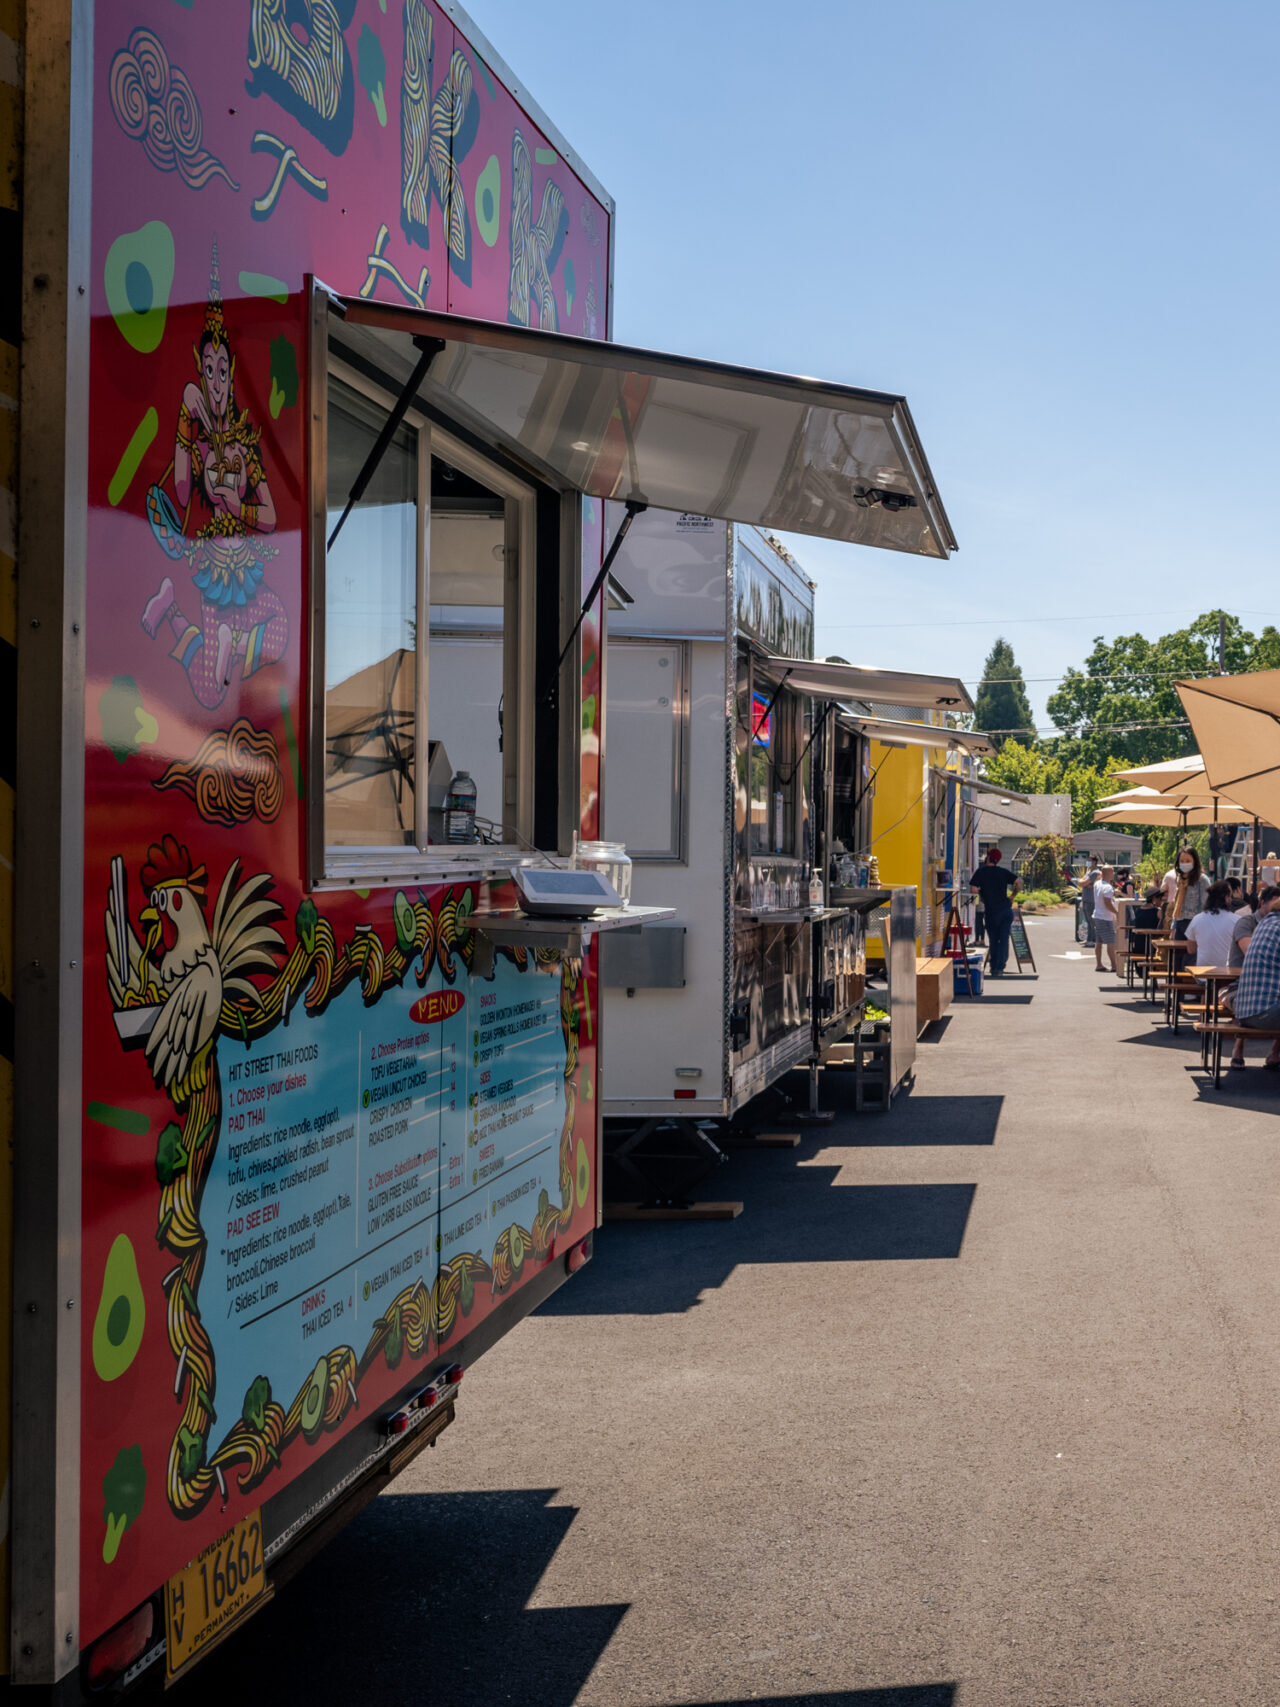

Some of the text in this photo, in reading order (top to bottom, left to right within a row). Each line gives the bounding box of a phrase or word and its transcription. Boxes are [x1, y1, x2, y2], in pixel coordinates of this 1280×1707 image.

[418, 993, 458, 1020] MENU
[229, 1043, 318, 1082] HIT STREET THAI FOODS
[378, 1042, 396, 1058] Choose
[397, 1036, 414, 1052] Protein
[371, 1063, 385, 1081] TOFU
[386, 1055, 417, 1076] VEGETARIAN
[229, 1073, 307, 1108] 1. Choose your dishes
[371, 1083, 389, 1104] VEGAN
[390, 1076, 407, 1097] UNCUT
[228, 1107, 266, 1134] PAD THAI
[370, 1104, 389, 1125] CRISPY
[390, 1096, 412, 1118] CHICKEN
[228, 1131, 272, 1163] Ingredients:
[274, 1126, 288, 1145] rice
[289, 1118, 313, 1139] noodle,
[369, 1124, 394, 1147] ROASTED
[395, 1118, 408, 1137] PORK
[228, 1166, 246, 1186] tofu,
[321, 1133, 335, 1152] bean
[336, 1123, 354, 1147] sprout
[236, 1186, 259, 1209] Sides:
[280, 1164, 307, 1192] crushed
[308, 1157, 328, 1183] peanut
[368, 1189, 389, 1213] GLUTEN
[390, 1182, 402, 1203] FREE
[403, 1174, 418, 1196] SAUCE
[375, 1169, 393, 1189] Choose
[227, 1202, 280, 1240] PAD SEE EEW
[367, 1213, 381, 1235] LOW
[381, 1206, 395, 1228] CARB
[396, 1197, 412, 1218] GLASS
[412, 1187, 431, 1210] NOODLE
[227, 1234, 272, 1267] Ingredients:
[273, 1226, 287, 1246] rice
[290, 1232, 316, 1262] broccoli
[444, 1229, 455, 1247] THAI
[455, 1221, 465, 1240] LIME
[466, 1215, 475, 1233] ICED
[371, 1271, 389, 1293] VEGAN
[390, 1262, 402, 1282] THAI
[402, 1254, 412, 1274] ICED
[413, 1248, 423, 1267] TEA
[235, 1288, 259, 1313] Sides:
[261, 1279, 278, 1301] Lime
[302, 1289, 326, 1316] DRINKS
[302, 1319, 317, 1340] THAI
[318, 1311, 332, 1333] ICED
[332, 1301, 344, 1320] TEA
[200, 1521, 262, 1618] 16662
[194, 1592, 246, 1647] PERMANENT
